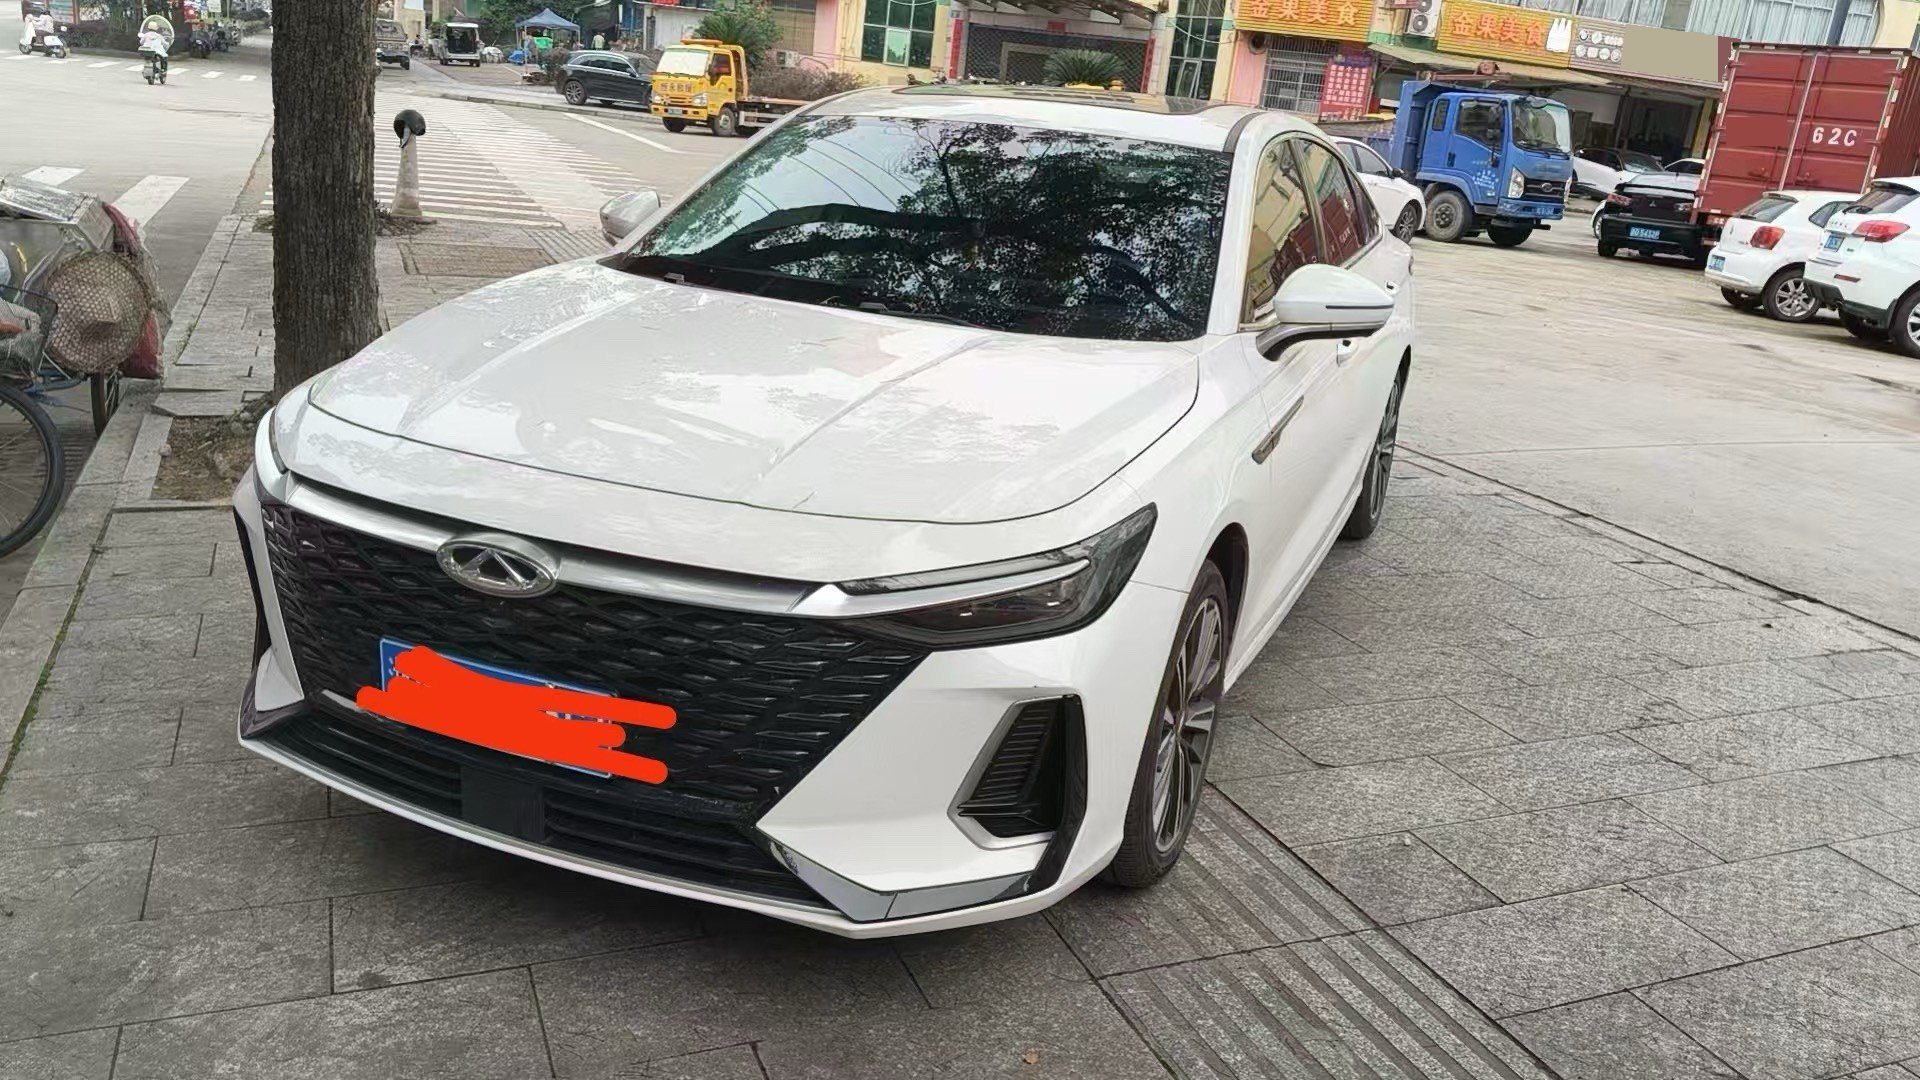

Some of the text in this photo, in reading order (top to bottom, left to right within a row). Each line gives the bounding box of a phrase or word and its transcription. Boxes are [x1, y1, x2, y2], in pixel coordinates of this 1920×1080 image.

[1250, 0, 1359, 26] 金果美食
[1452, 12, 1545, 46] 金果美食
[1812, 127, 1857, 147] 62C
